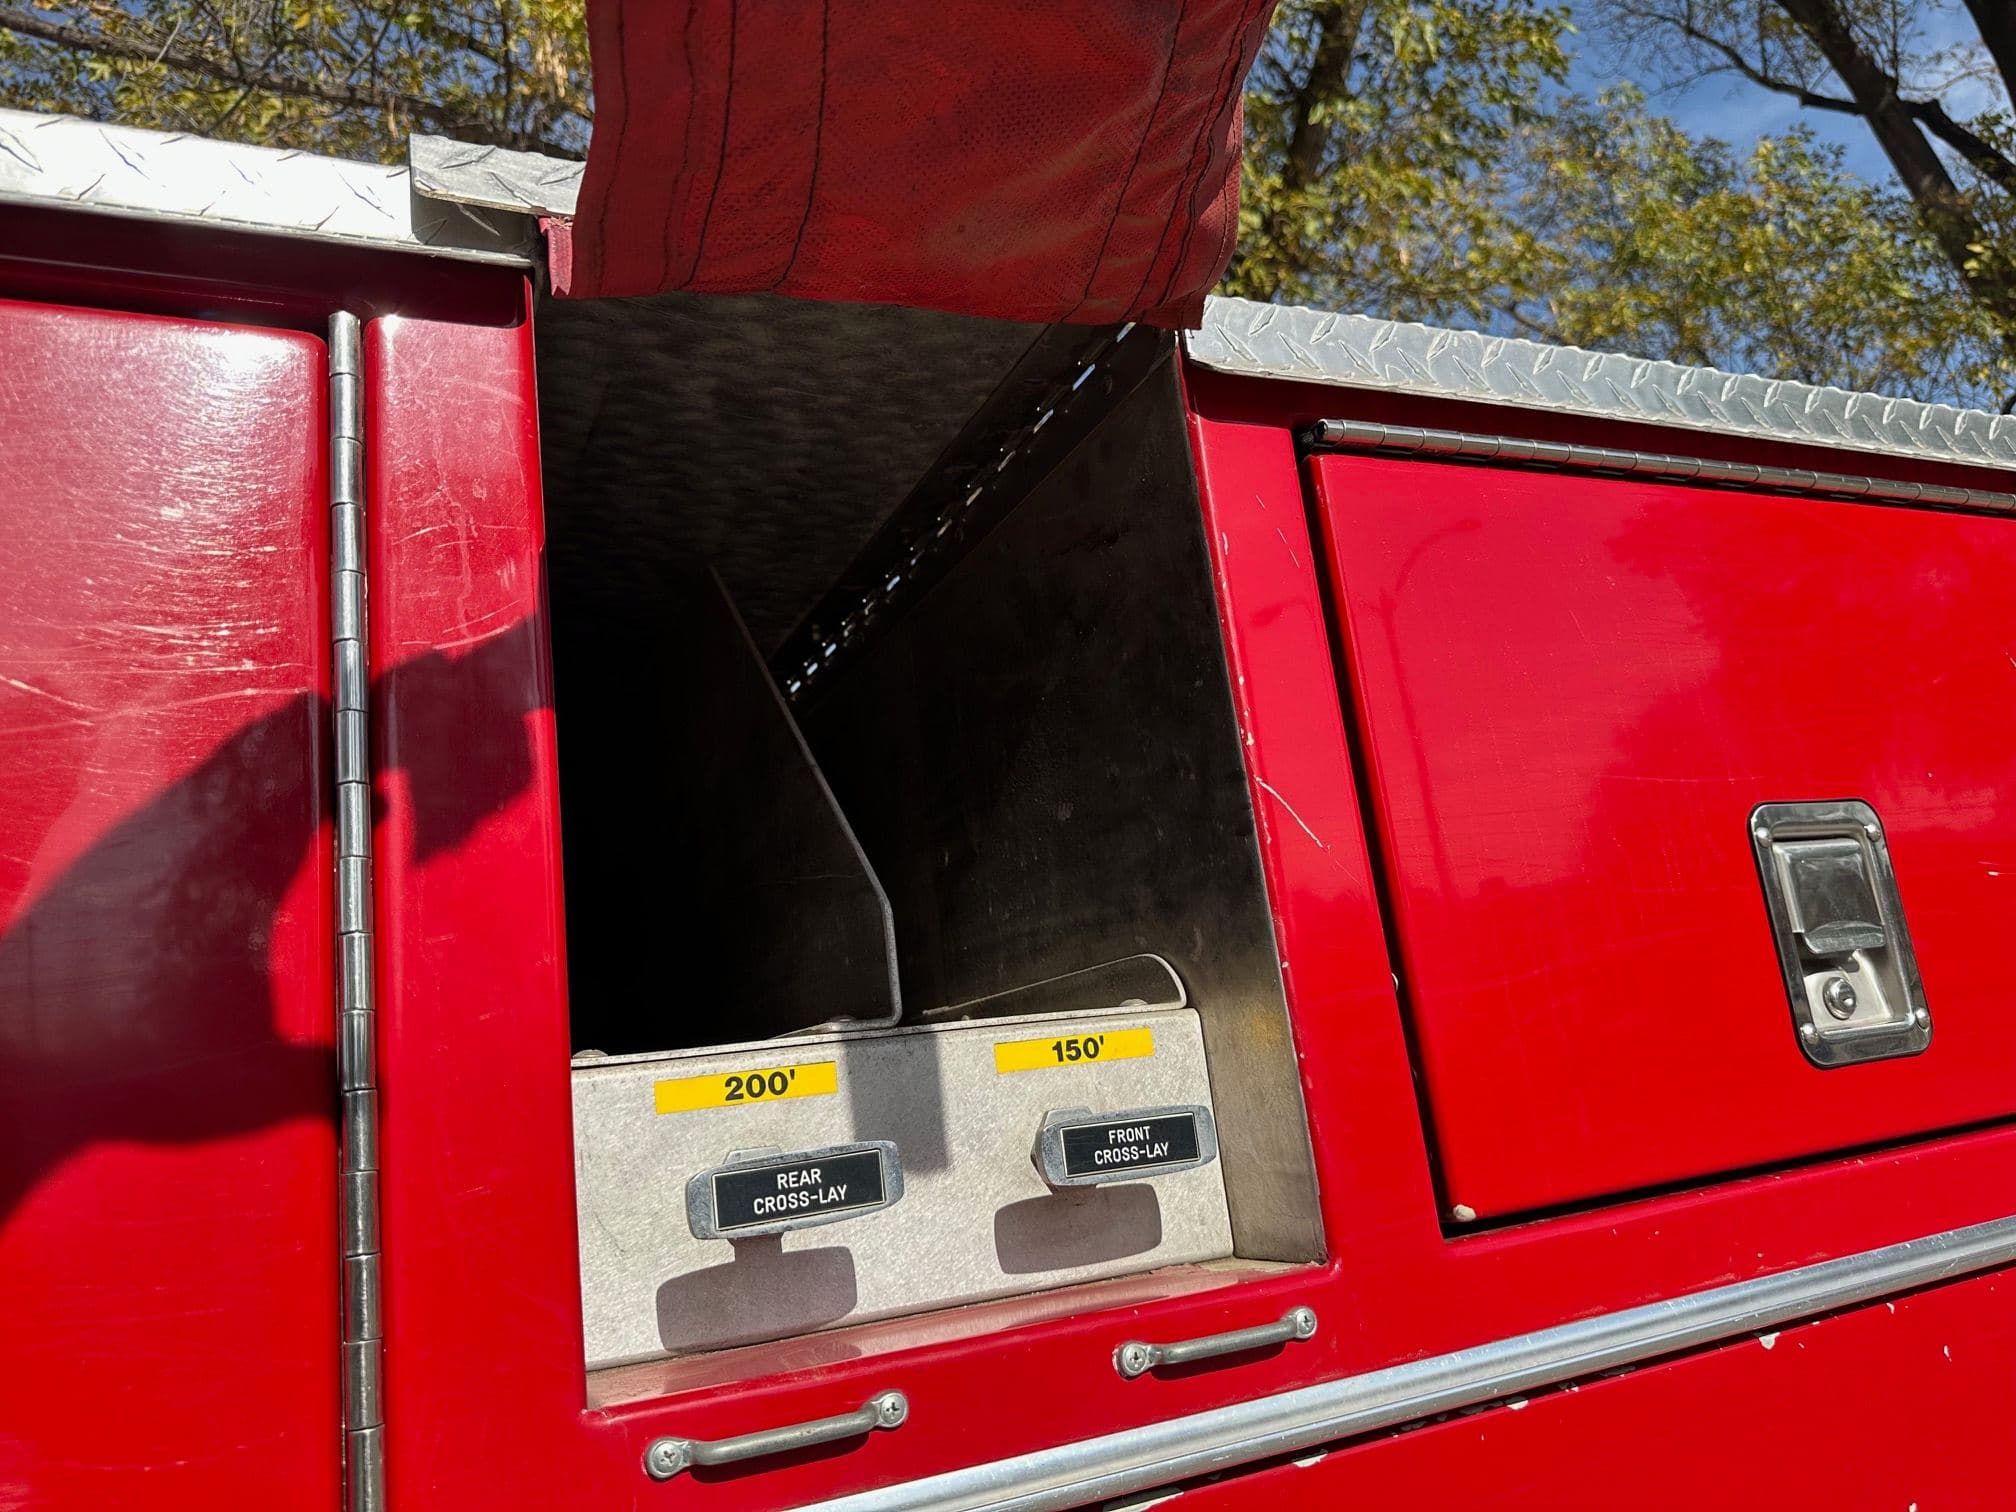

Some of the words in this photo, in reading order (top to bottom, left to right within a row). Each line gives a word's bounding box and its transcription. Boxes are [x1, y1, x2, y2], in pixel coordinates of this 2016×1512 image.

[1052, 1035, 1104, 1062] 150'
[724, 1069, 796, 1101] 200'
[1108, 1126, 1150, 1145] FRONT
[1094, 1142, 1169, 1165] CROSS-LAY
[777, 1168, 822, 1190] REAR
[753, 1184, 847, 1215] CROSS-LAY
